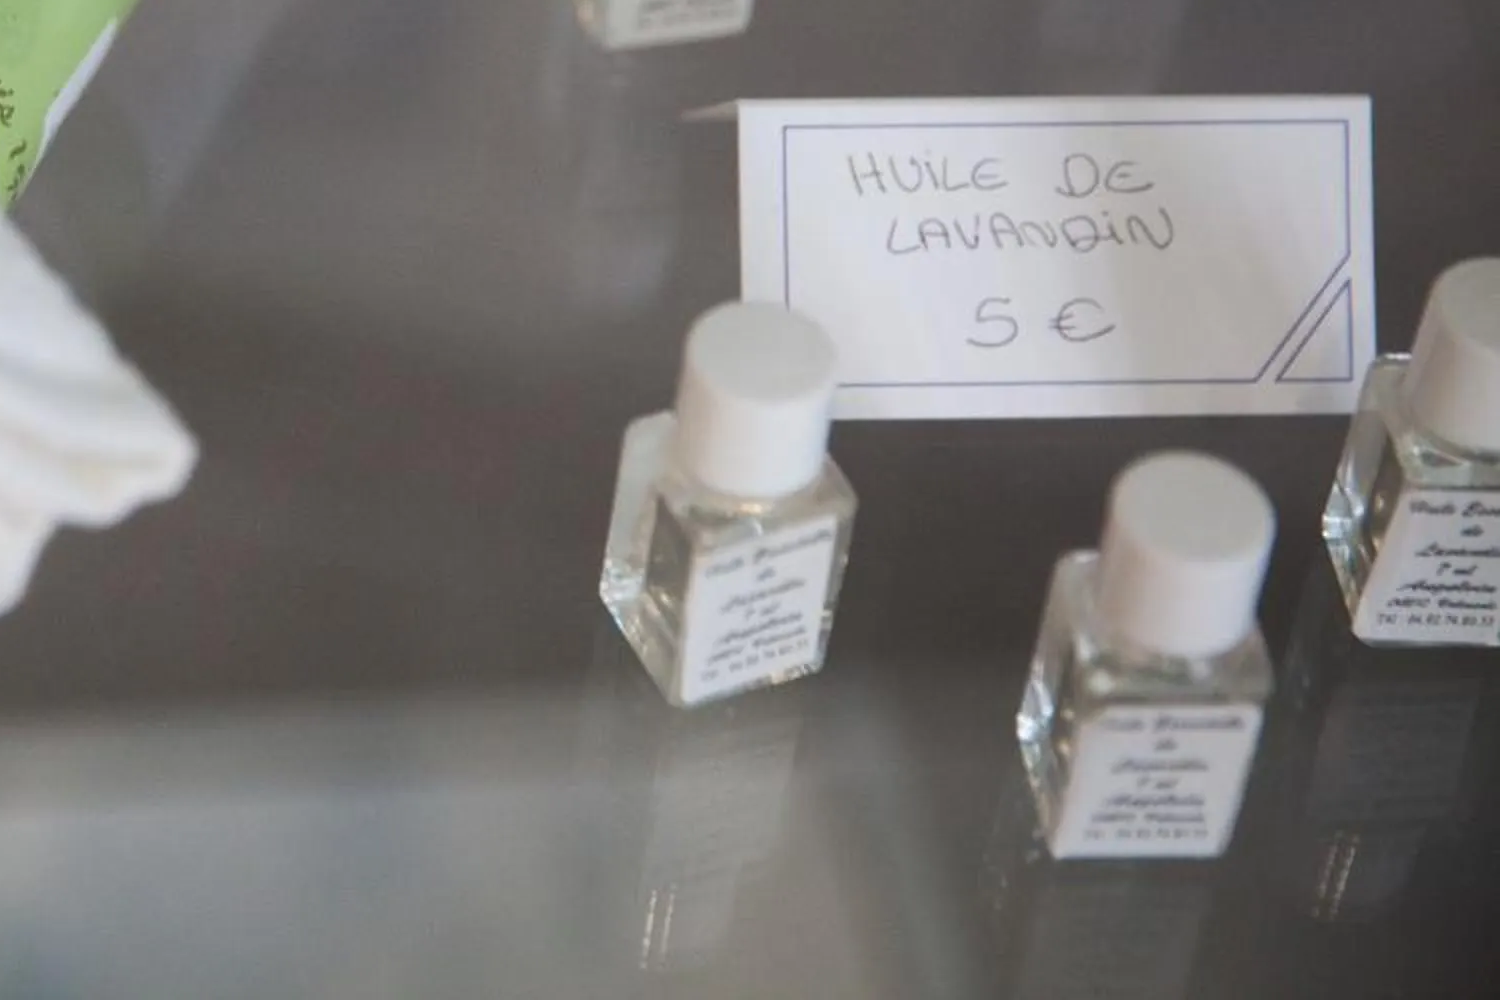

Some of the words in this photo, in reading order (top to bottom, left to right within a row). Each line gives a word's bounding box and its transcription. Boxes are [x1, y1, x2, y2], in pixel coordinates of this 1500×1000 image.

[1054, 153, 1155, 199] DE
[966, 297, 1020, 347] 5
[1048, 298, 1117, 343] €
